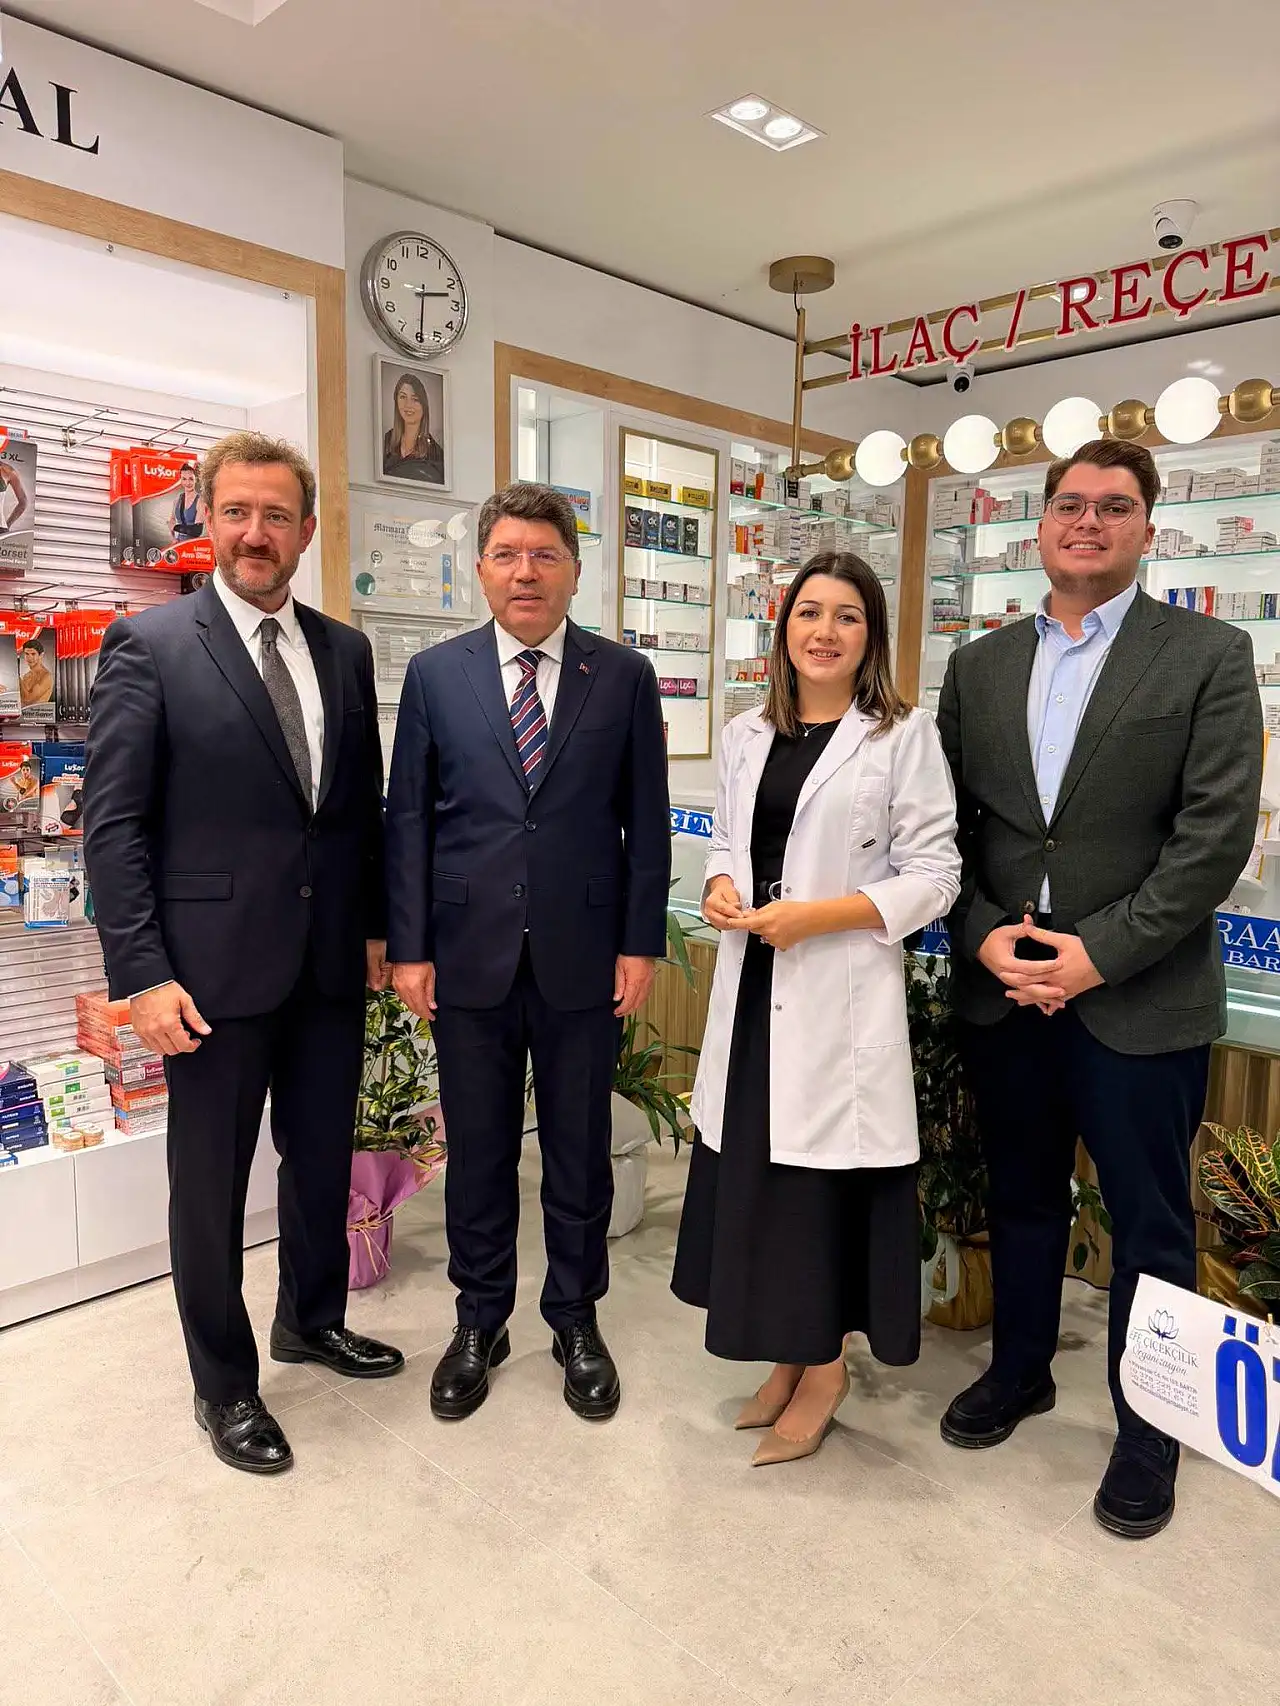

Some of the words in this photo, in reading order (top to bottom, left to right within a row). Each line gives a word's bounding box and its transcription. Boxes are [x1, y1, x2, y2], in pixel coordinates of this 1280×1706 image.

[402, 246, 409, 259] 11
[416, 245, 429, 259] 12
[387, 258, 397, 270] 10
[438, 258, 441, 270] 1
[381, 278, 390, 289] 9
[447, 277, 456, 290] 2
[385, 301, 396, 313] 8
[450, 300, 460, 312] 3
[848, 304, 980, 380] İLAÇ
[1057, 235, 1270, 336] REÇE
[398, 320, 408, 332] 7
[445, 320, 454, 331] 4
[432, 331, 442, 343] 5
[144, 463, 177, 479] Luxor
[1216, 1313, 1280, 1482] Ö
